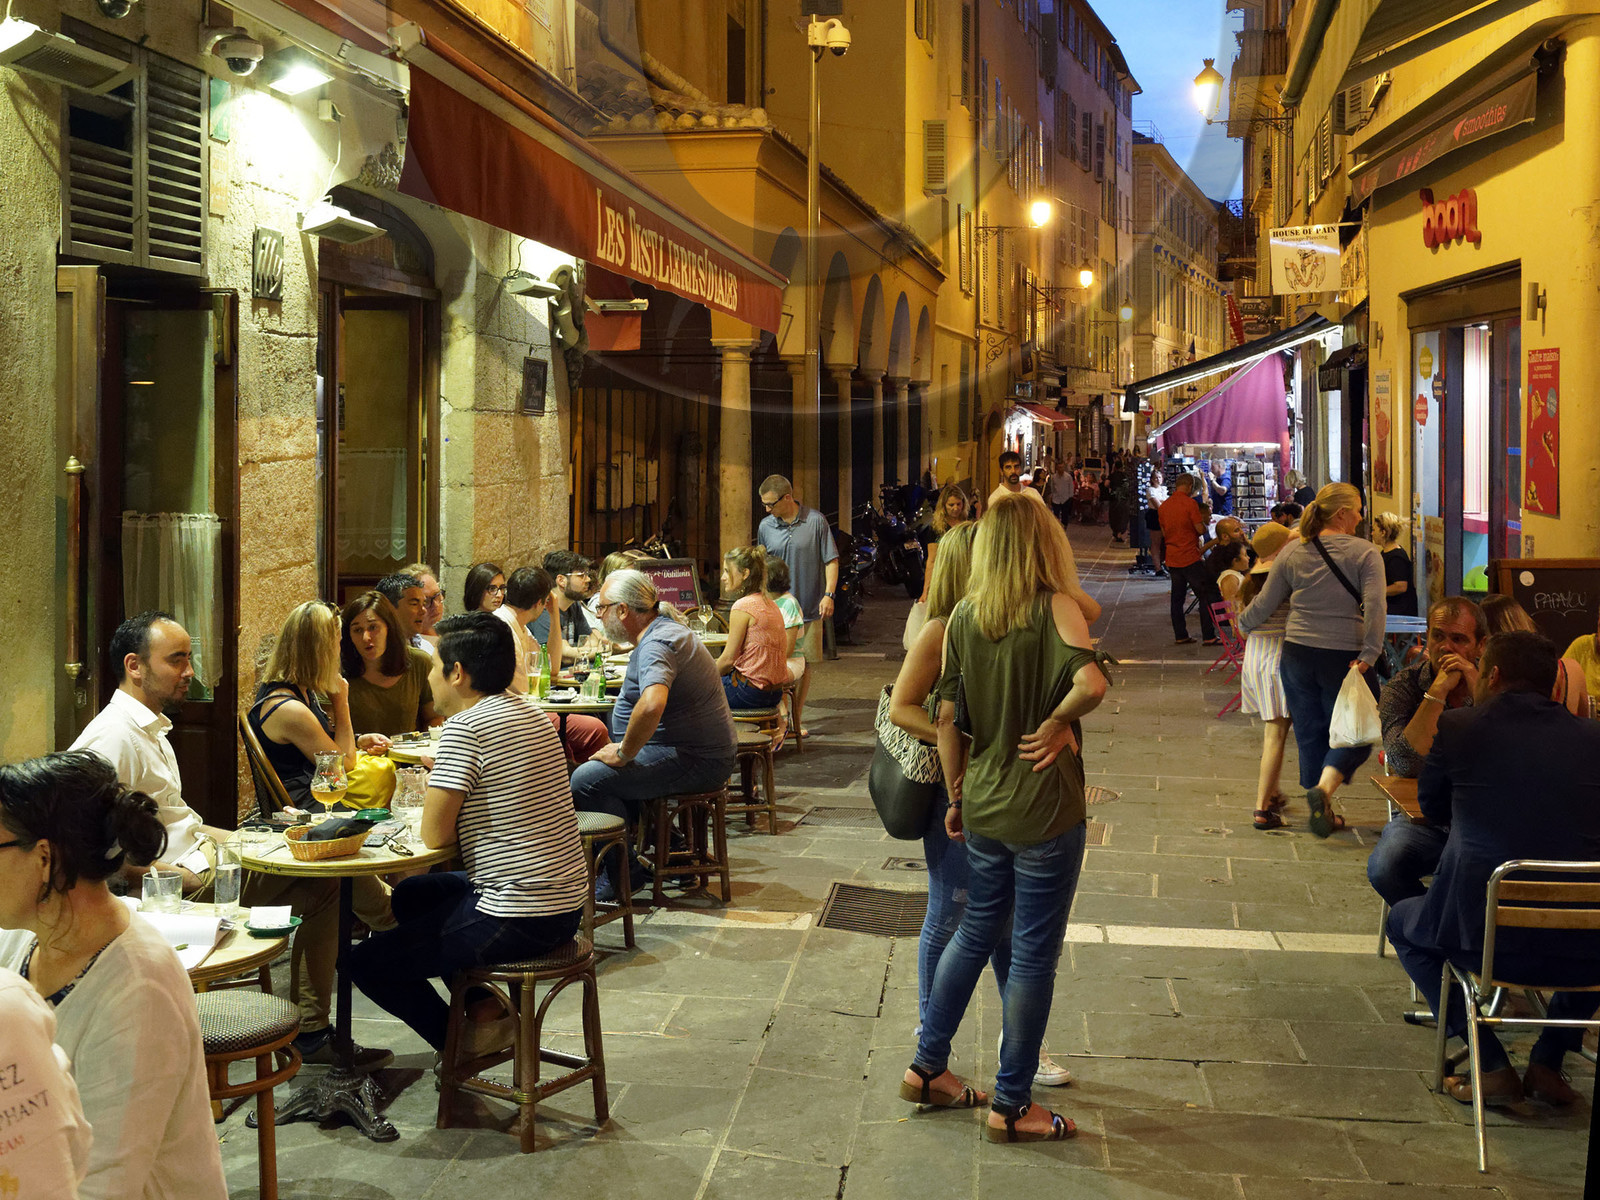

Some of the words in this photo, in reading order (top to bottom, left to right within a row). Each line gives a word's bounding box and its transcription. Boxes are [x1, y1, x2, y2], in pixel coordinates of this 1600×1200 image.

[1461, 104, 1508, 137] smoothies
[596, 188, 626, 267] LES
[1272, 230, 1300, 238] HOUSE
[1316, 226, 1336, 234] PAIN
